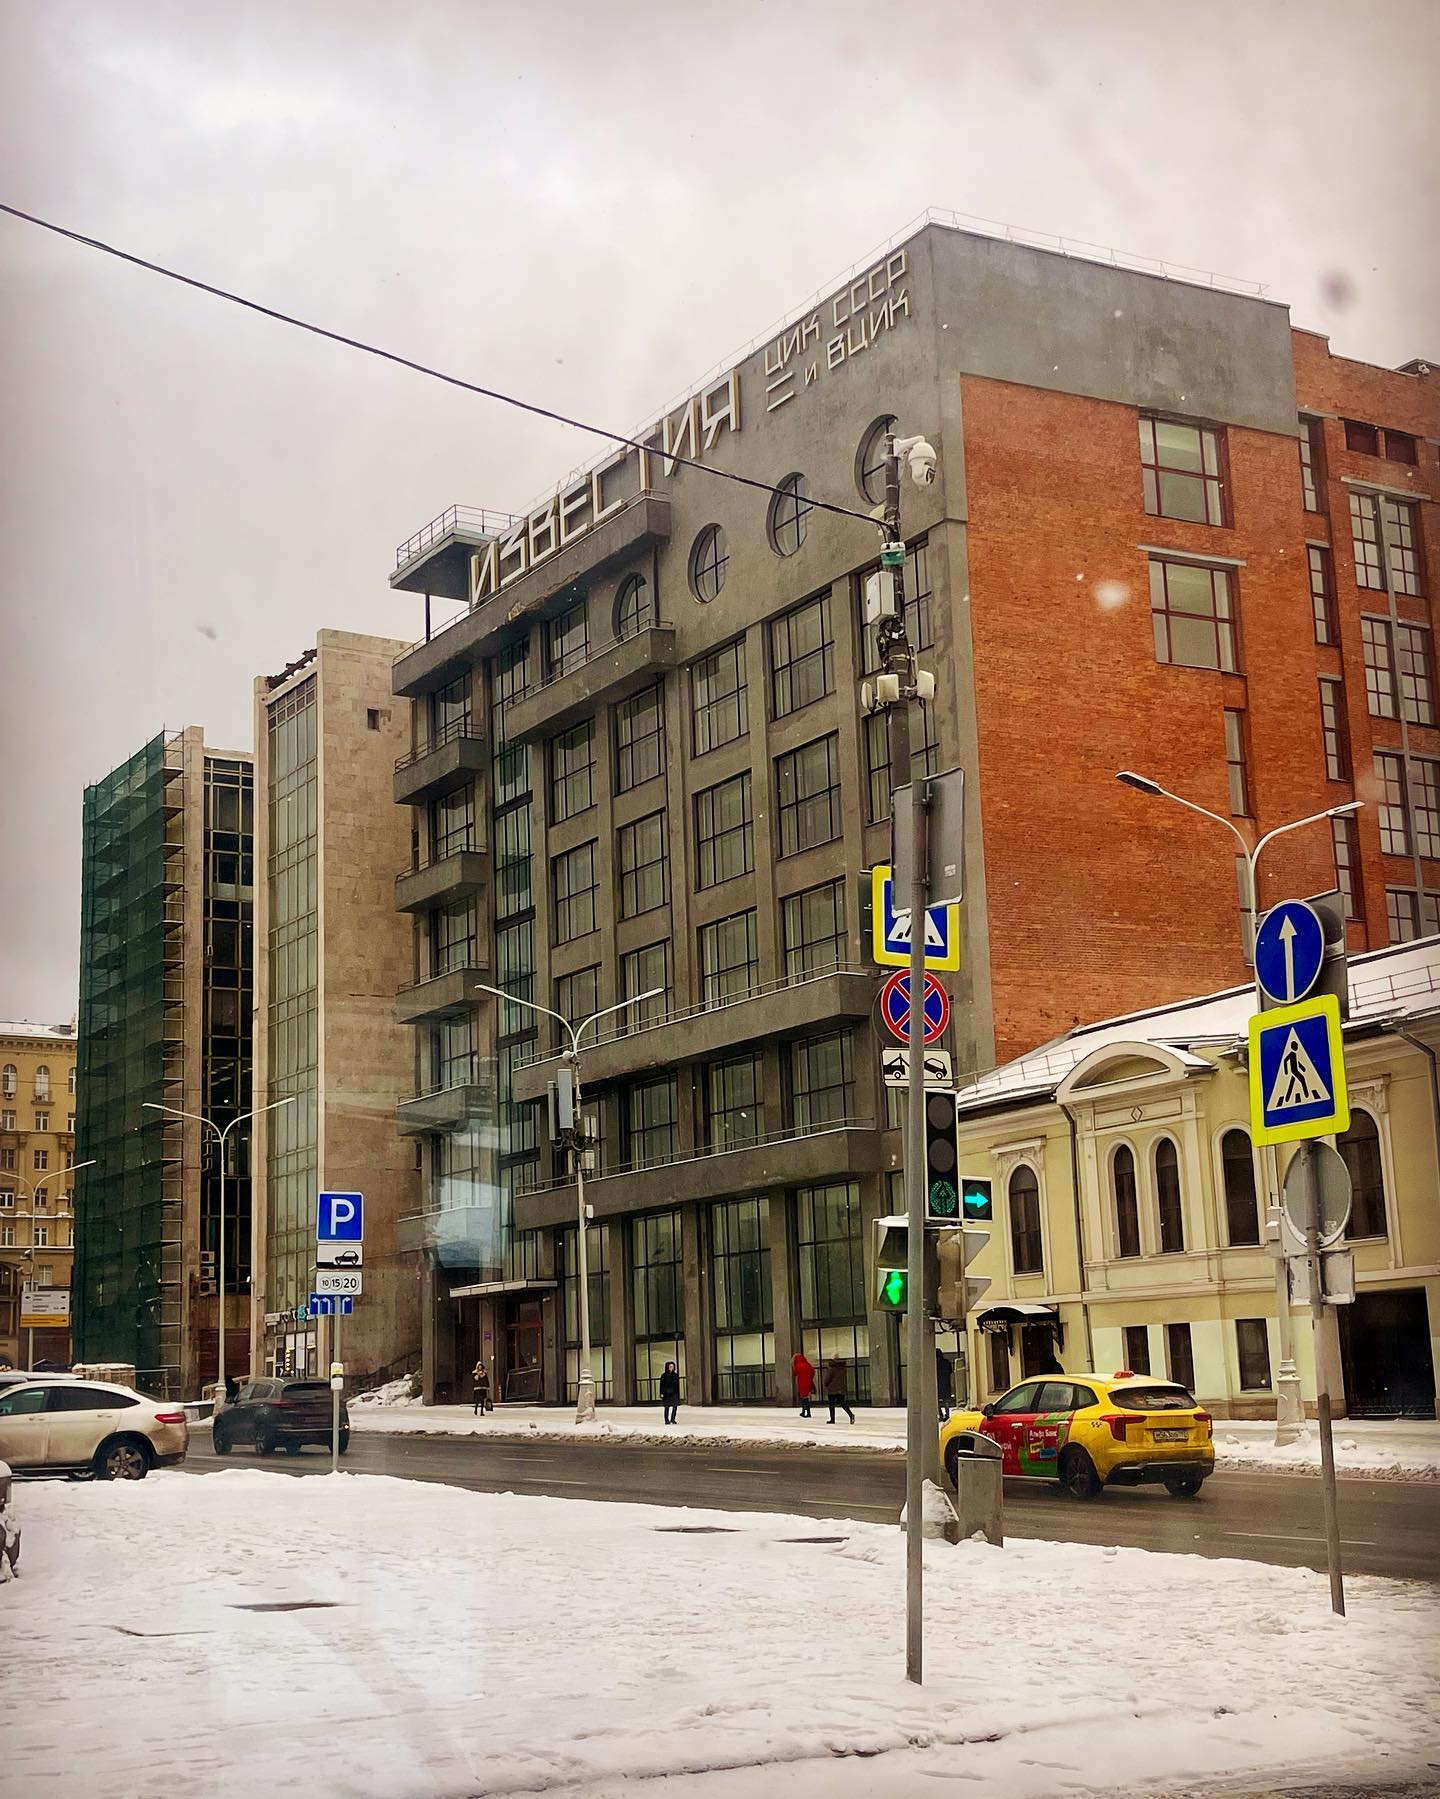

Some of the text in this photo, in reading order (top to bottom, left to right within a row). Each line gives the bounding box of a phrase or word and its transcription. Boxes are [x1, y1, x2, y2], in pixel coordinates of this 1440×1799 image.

[765, 249, 907, 376] ЦИК СССР
[827, 288, 910, 370] ВЦИК
[470, 368, 741, 605] ИЗВЕСТИЯ
[330, 1198, 355, 1236] P
[321, 1277, 357, 1289] 10 15 20
